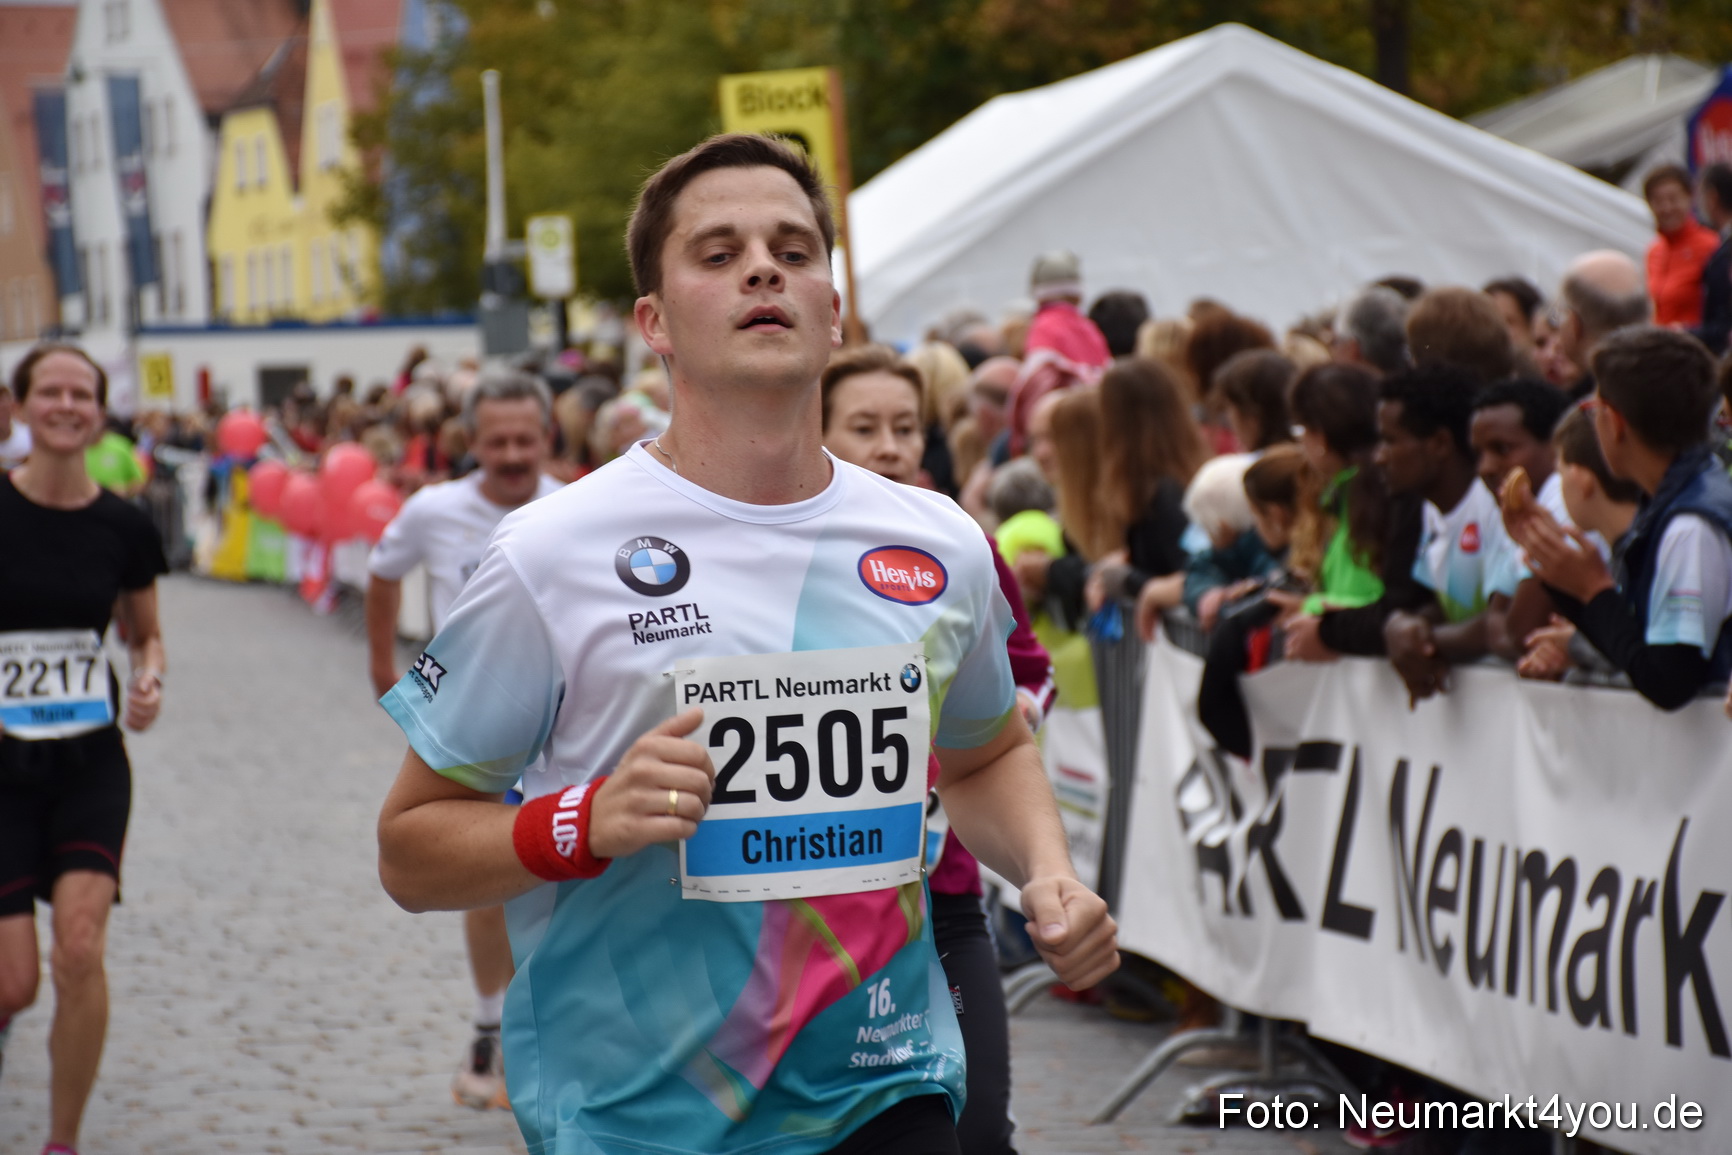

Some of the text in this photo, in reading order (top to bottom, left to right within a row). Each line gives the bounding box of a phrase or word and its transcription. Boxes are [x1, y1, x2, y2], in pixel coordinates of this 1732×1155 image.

[737, 82, 825, 117] Block
[618, 538, 679, 559] BMW
[868, 559, 936, 591] Hervis
[628, 603, 709, 631] PARTL
[633, 622, 712, 645] Neumarkt
[3, 655, 97, 698] 2217
[684, 679, 769, 704] PARTL
[776, 672, 892, 698] Neumarkt
[709, 706, 909, 805] 2505
[552, 810, 579, 857] LOS
[742, 824, 883, 864] Christian
[867, 977, 896, 1019] 16.
